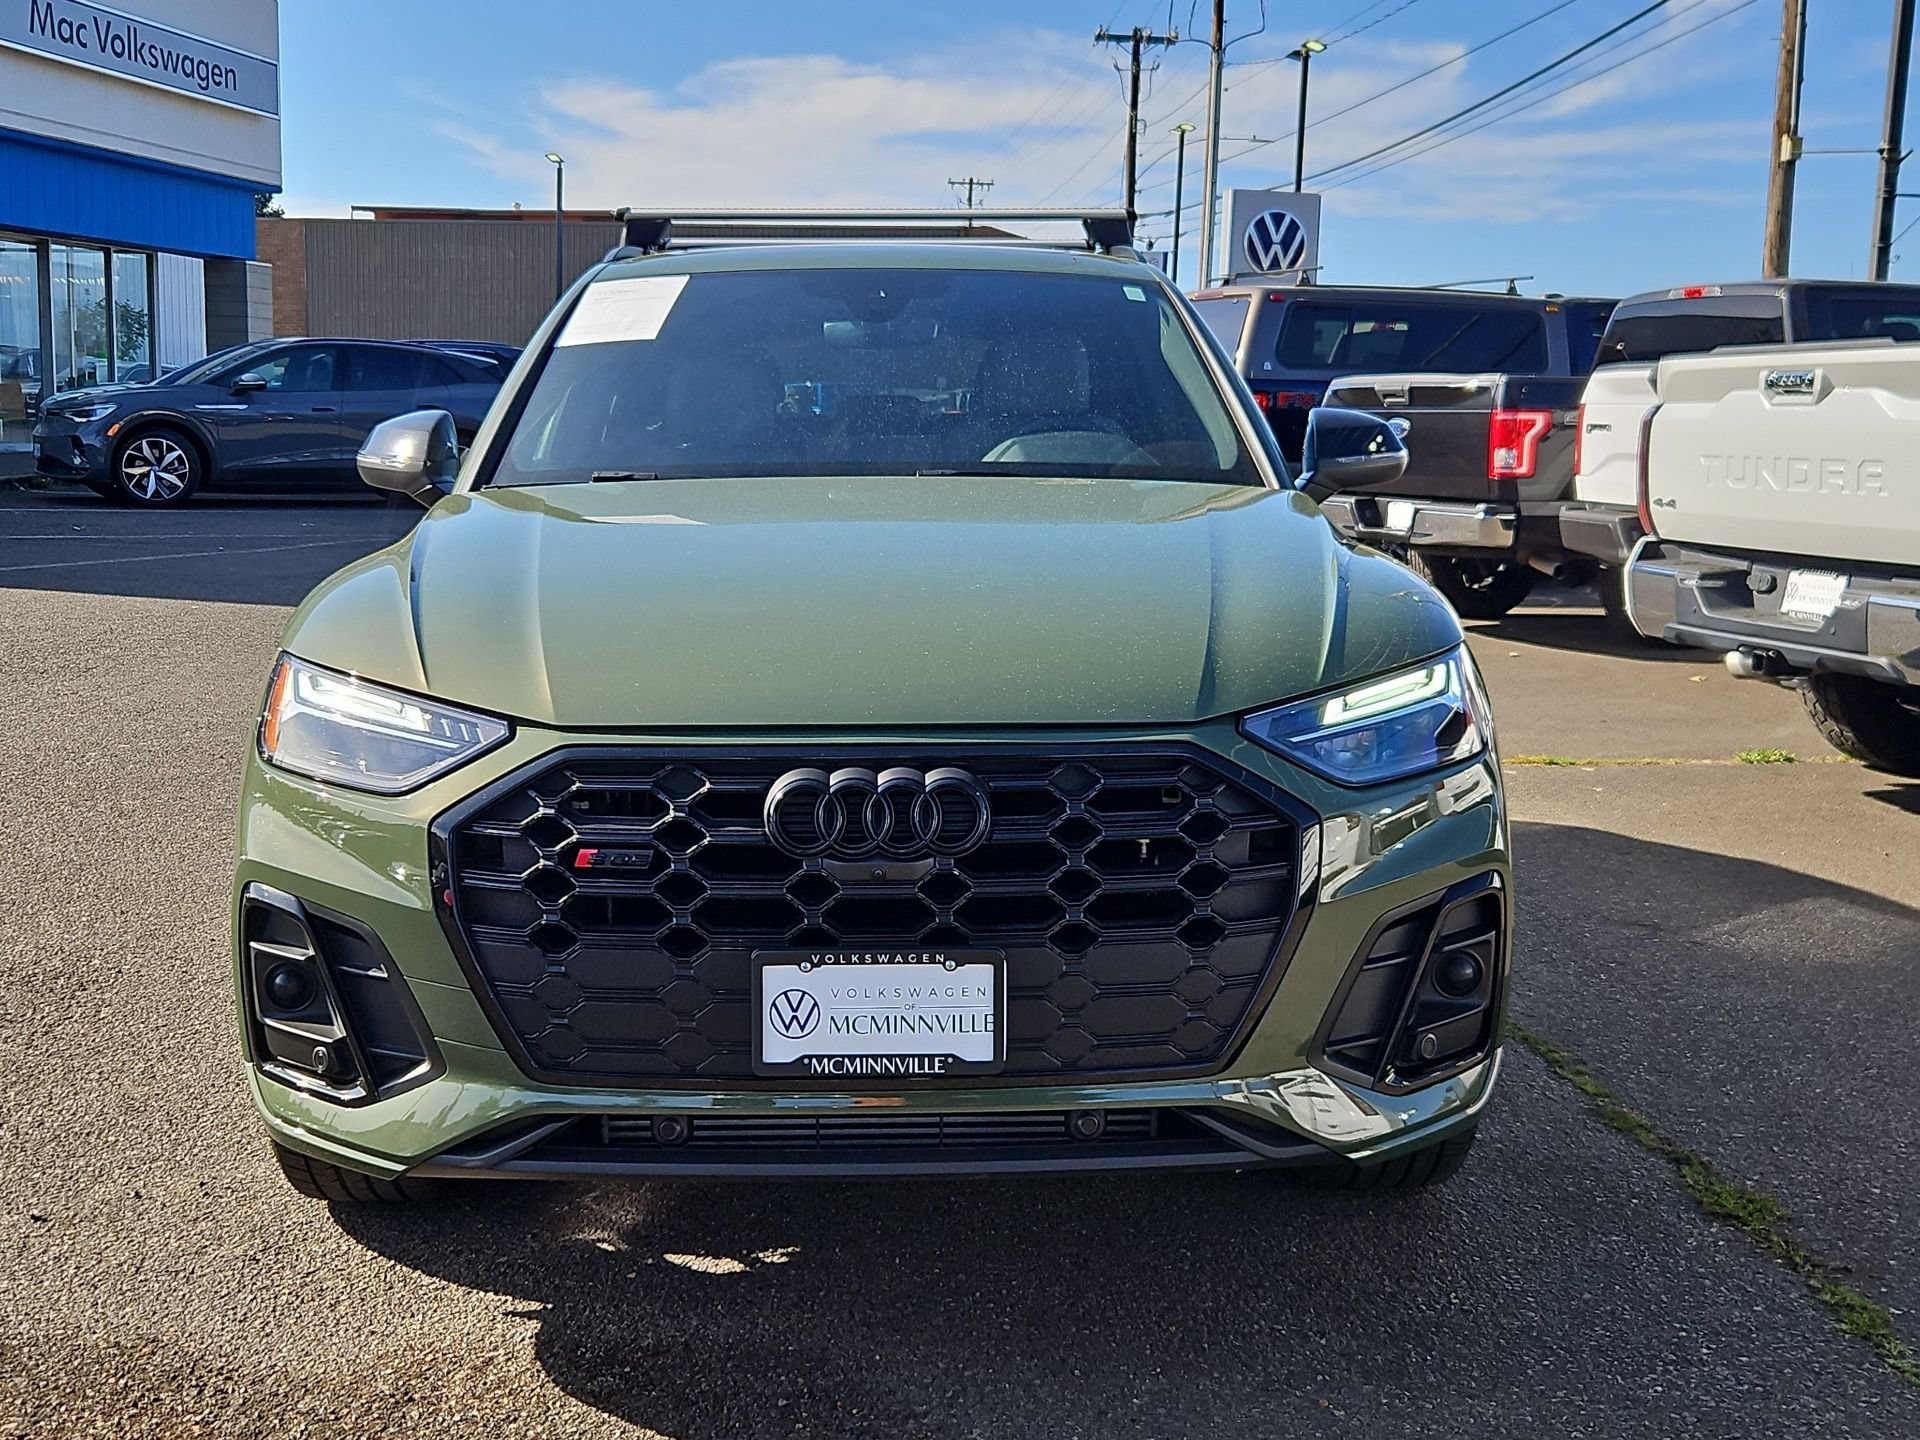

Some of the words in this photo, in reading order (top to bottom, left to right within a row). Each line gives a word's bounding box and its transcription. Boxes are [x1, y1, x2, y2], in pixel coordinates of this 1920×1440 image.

[29, 0, 88, 49] Mac
[92, 15, 238, 91] Volkswagen
[1700, 455, 1890, 497] TUNDRA
[811, 953, 945, 964] VOLKSWAGEN
[830, 986, 987, 999] VOLKSWAGEN
[903, 1003, 916, 1012] OF
[829, 1013, 995, 1035] MCMINNVILLE
[810, 1056, 946, 1075] MCMINNVILLE
